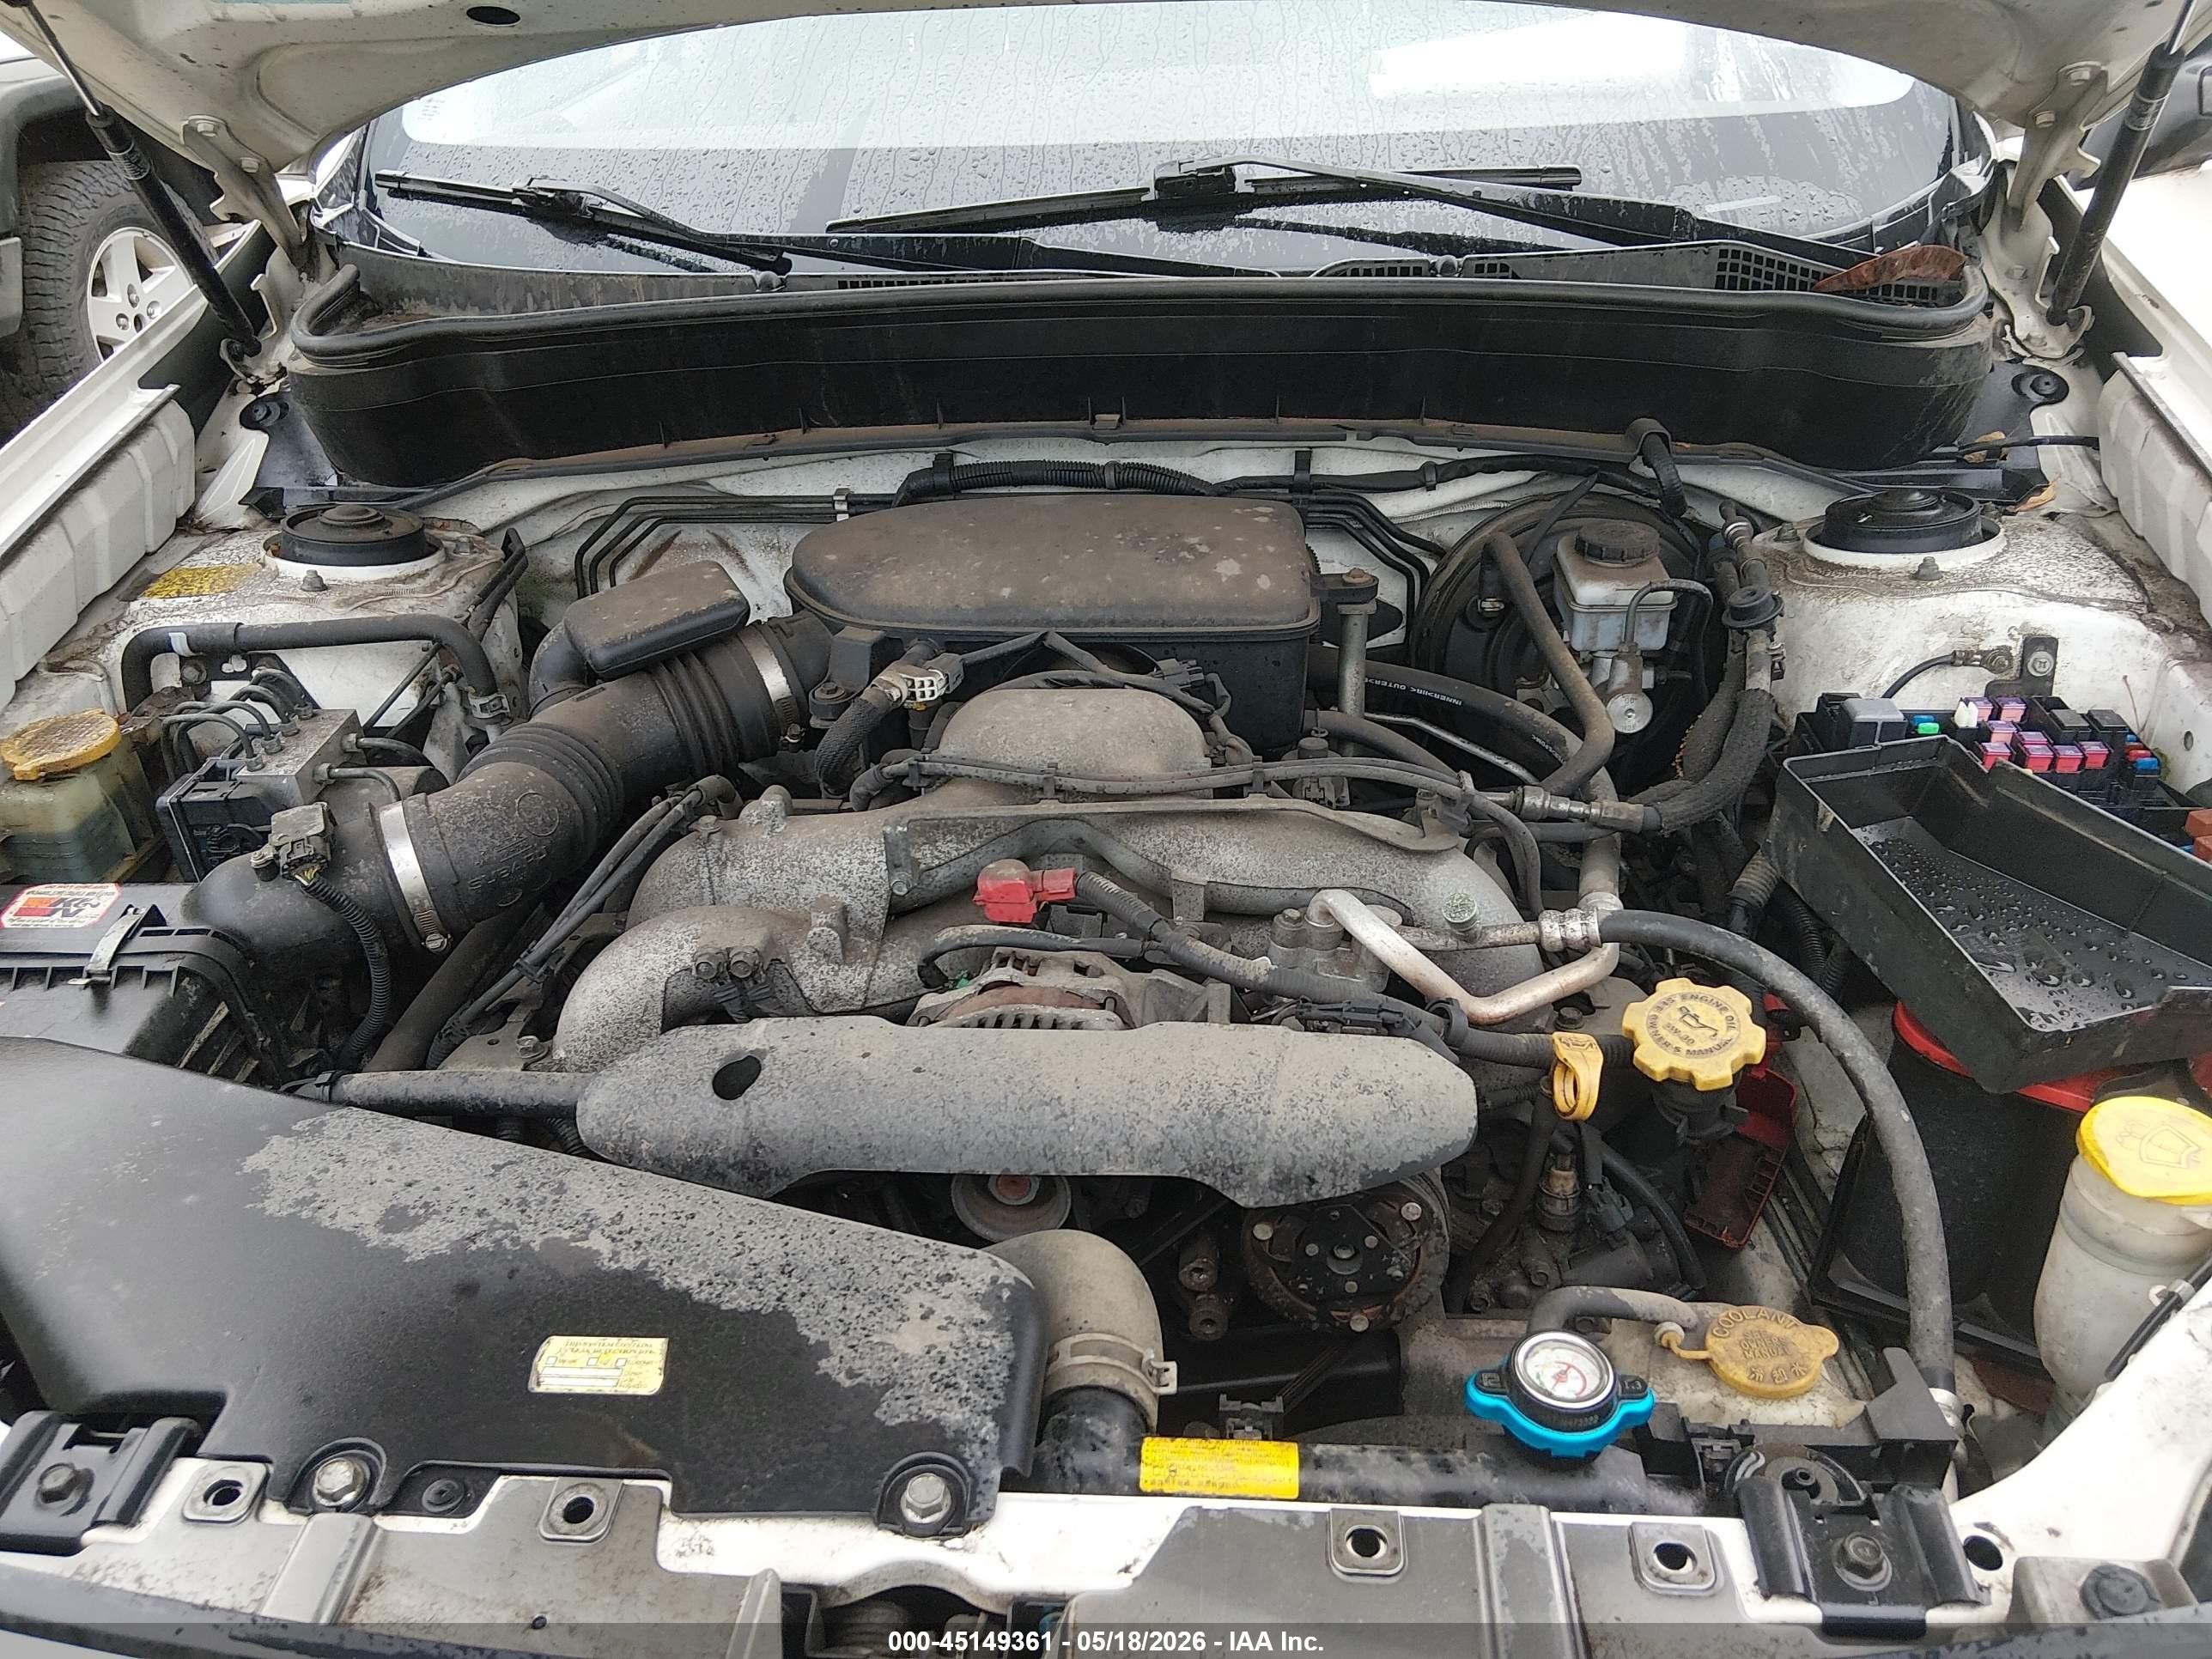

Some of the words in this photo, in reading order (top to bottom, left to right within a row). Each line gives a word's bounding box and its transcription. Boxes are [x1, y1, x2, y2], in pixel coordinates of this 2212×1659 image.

[1680, 993, 1729, 1015] ENGINE
[1724, 1014, 1737, 1031] OIL
[1712, 1308, 1800, 1339] COOLANT
[1743, 1346, 1792, 1359] MANUAL
